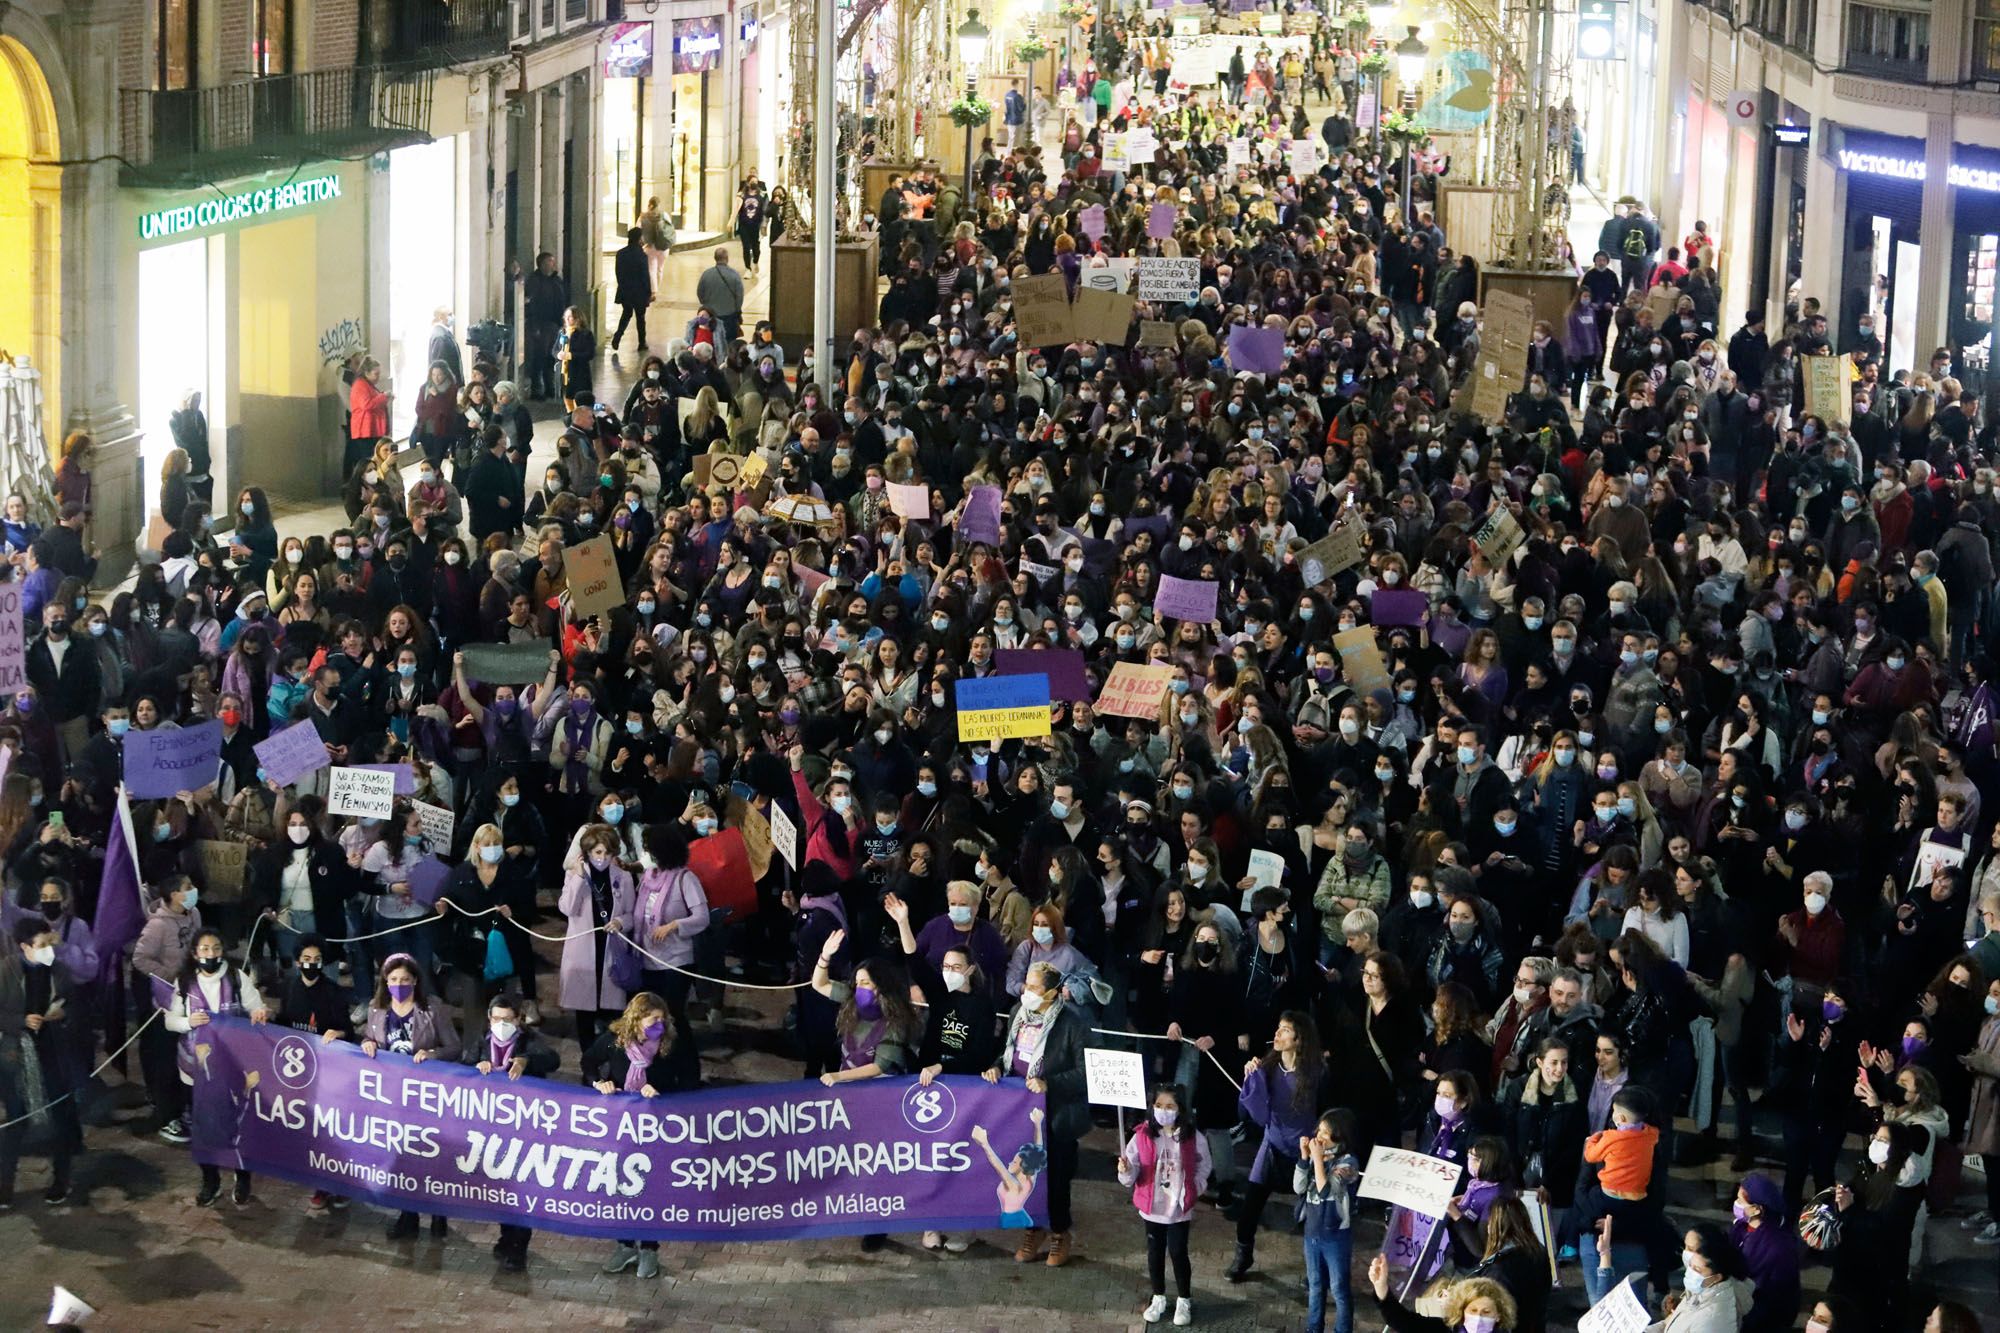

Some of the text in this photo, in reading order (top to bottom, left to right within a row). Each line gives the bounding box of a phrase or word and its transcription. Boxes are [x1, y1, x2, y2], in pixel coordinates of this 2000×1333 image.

[1839, 150, 1926, 180] VICTORIA'S
[140, 206, 195, 239] UNITED
[197, 193, 252, 227] COLORS
[254, 188, 274, 215] OF
[1141, 260, 1200, 269] HAY QUE ACTUAR
[1165, 269, 1184, 278] FUERA
[1141, 280, 1200, 290] POSIBLE CAMBIAR
[584, 580, 607, 597] COÑO
[1108, 674, 1164, 696] LIBRES
[964, 713, 978, 725] LAS
[979, 712, 1006, 723] MUJERES
[151, 731, 212, 751] FEMINISMO
[964, 727, 974, 738] NO
[975, 727, 984, 737] SE
[351, 772, 391, 785] ESTAMOS
[360, 784, 392, 797] TENEMOS
[341, 793, 390, 813] FEMINISMO
[359, 1069, 851, 1146] EL FEMINISMO ES ABOLICIONISTA
[255, 1091, 972, 1199] LAS MUJERES JUNTAS SOMOS IMPARABLES
[309, 1150, 906, 1227] Movimiento feminista y asociativo de mujeres de Málaga
[1368, 1176, 1447, 1208] GUERRAS
